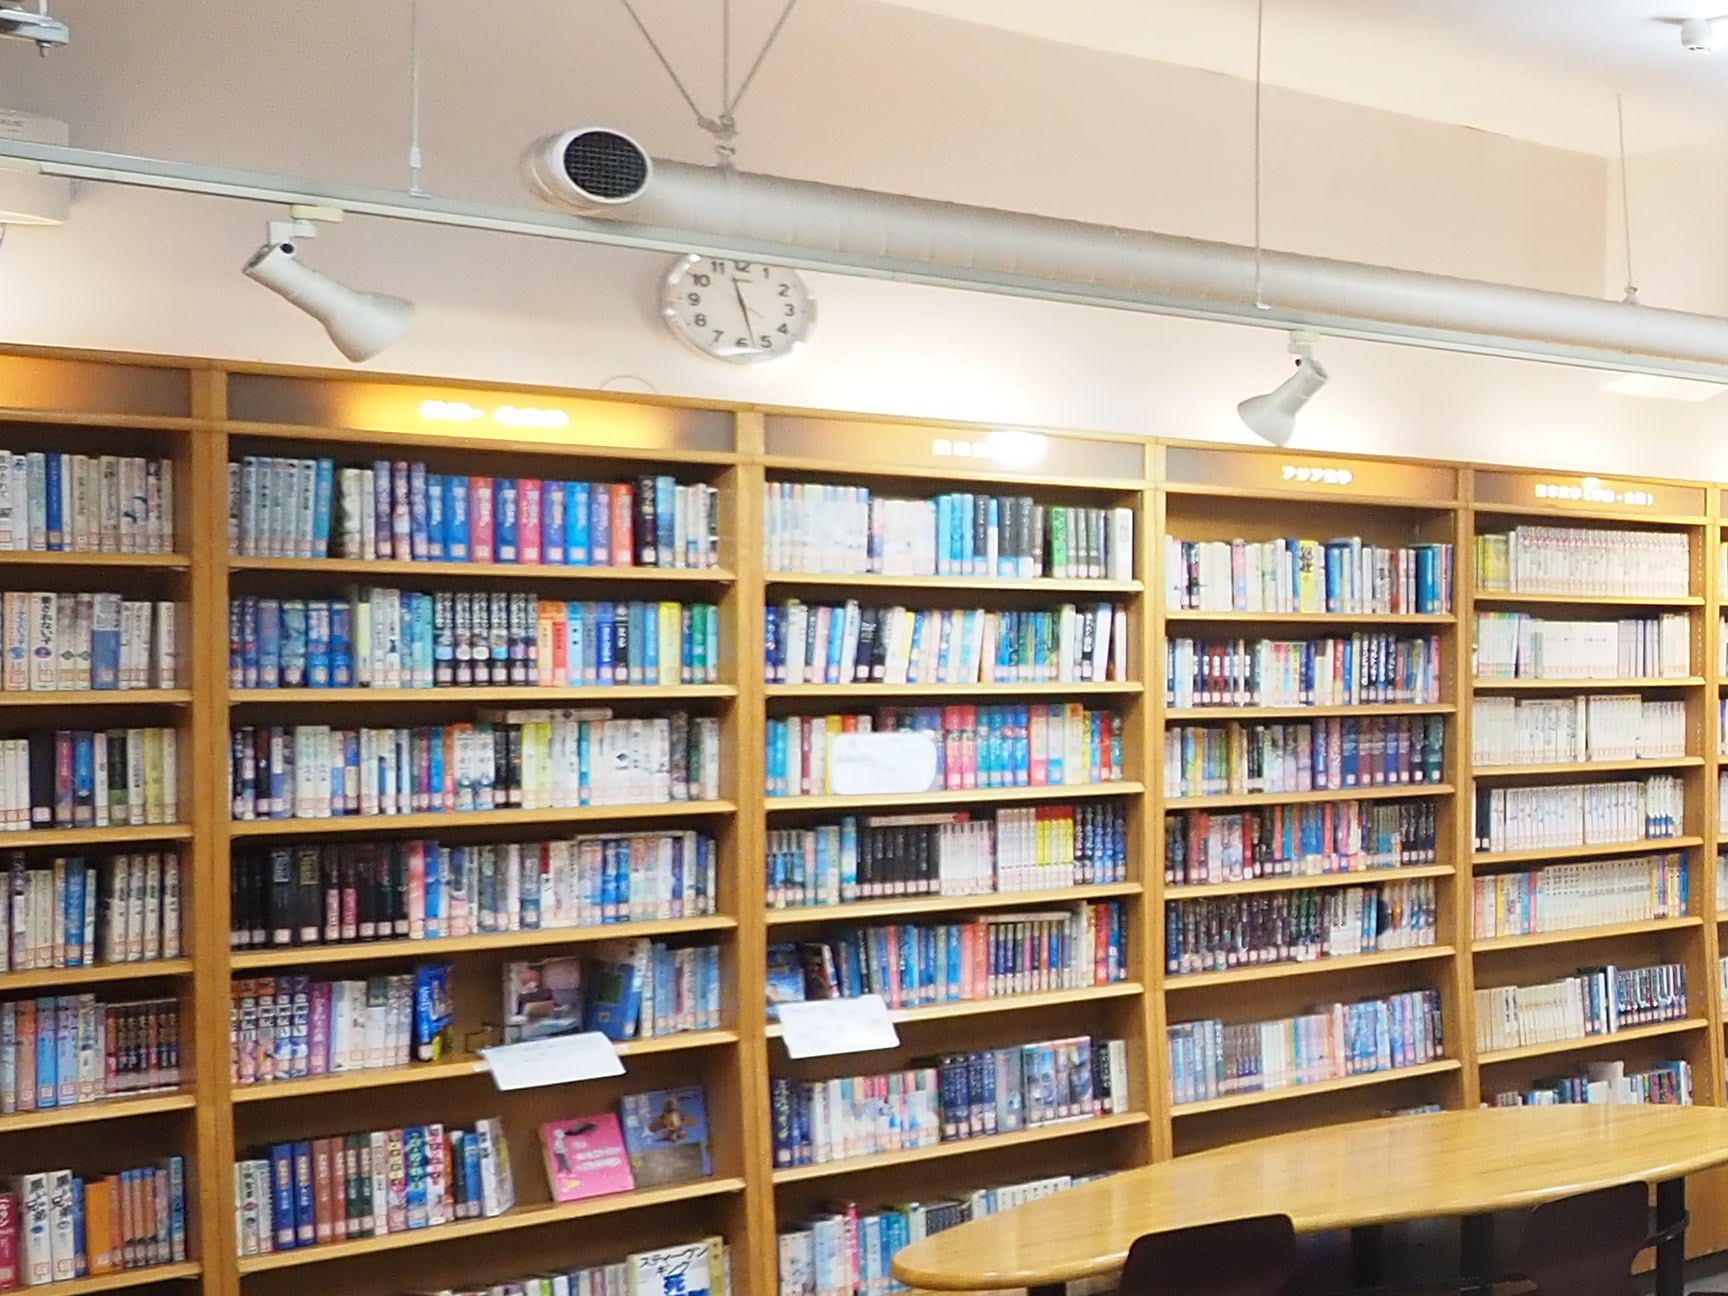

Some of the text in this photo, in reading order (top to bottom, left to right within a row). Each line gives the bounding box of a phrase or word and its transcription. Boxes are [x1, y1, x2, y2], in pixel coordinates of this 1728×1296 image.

[711, 261, 725, 273] 11
[762, 267, 770, 279] 1
[692, 274, 711, 287] 10
[778, 284, 790, 297] 2
[688, 292, 700, 306] 9
[784, 304, 795, 316] 3
[694, 314, 707, 327] 8
[777, 323, 789, 335] 4
[712, 330, 725, 342] 7
[760, 336, 772, 348] 5
